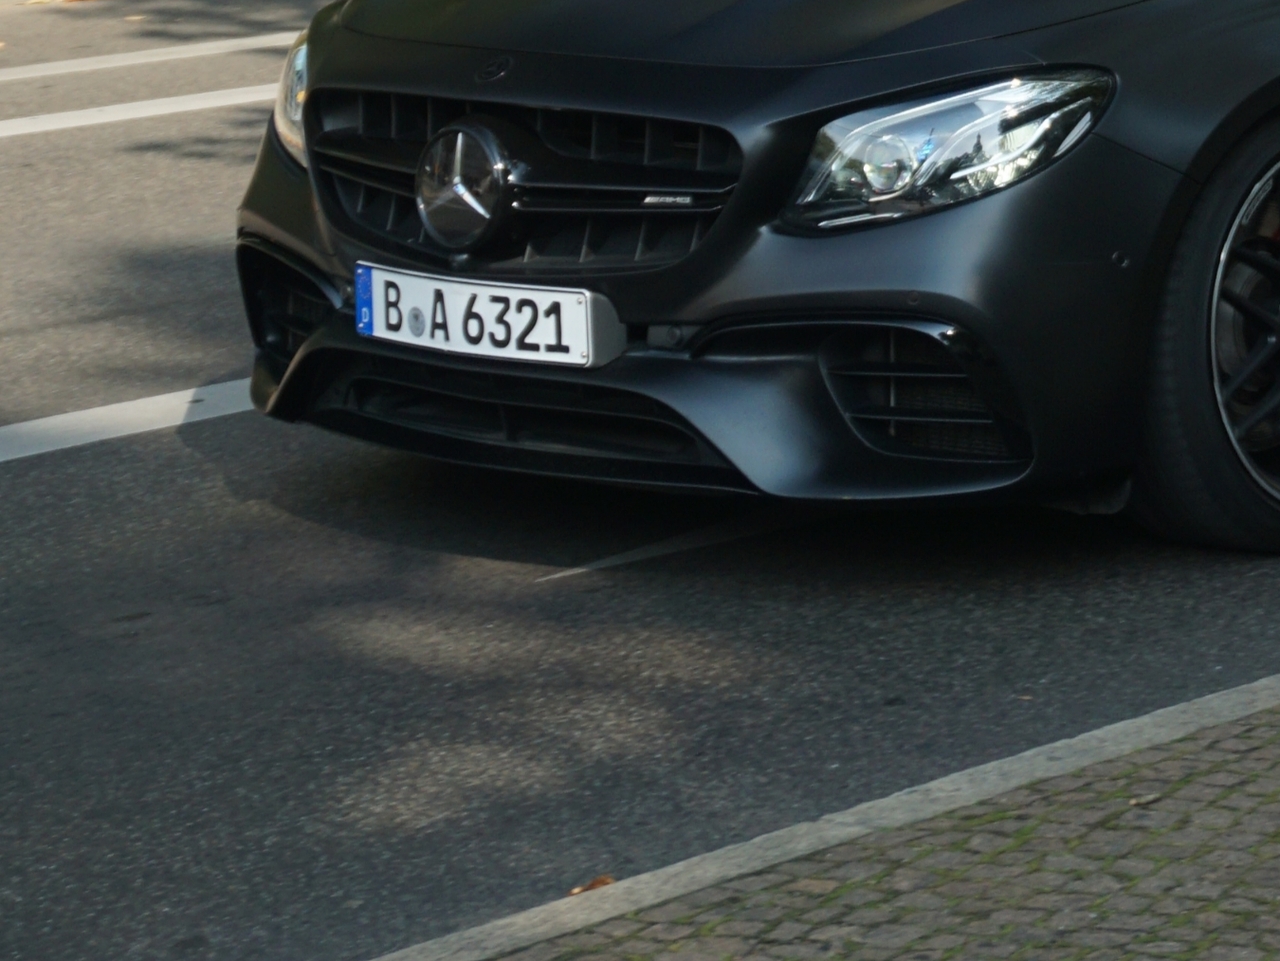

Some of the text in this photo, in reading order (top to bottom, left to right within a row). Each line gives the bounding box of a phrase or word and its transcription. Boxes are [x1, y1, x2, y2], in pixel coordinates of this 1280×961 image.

[361, 307, 370, 322] D
[384, 280, 570, 354] B A 6321
